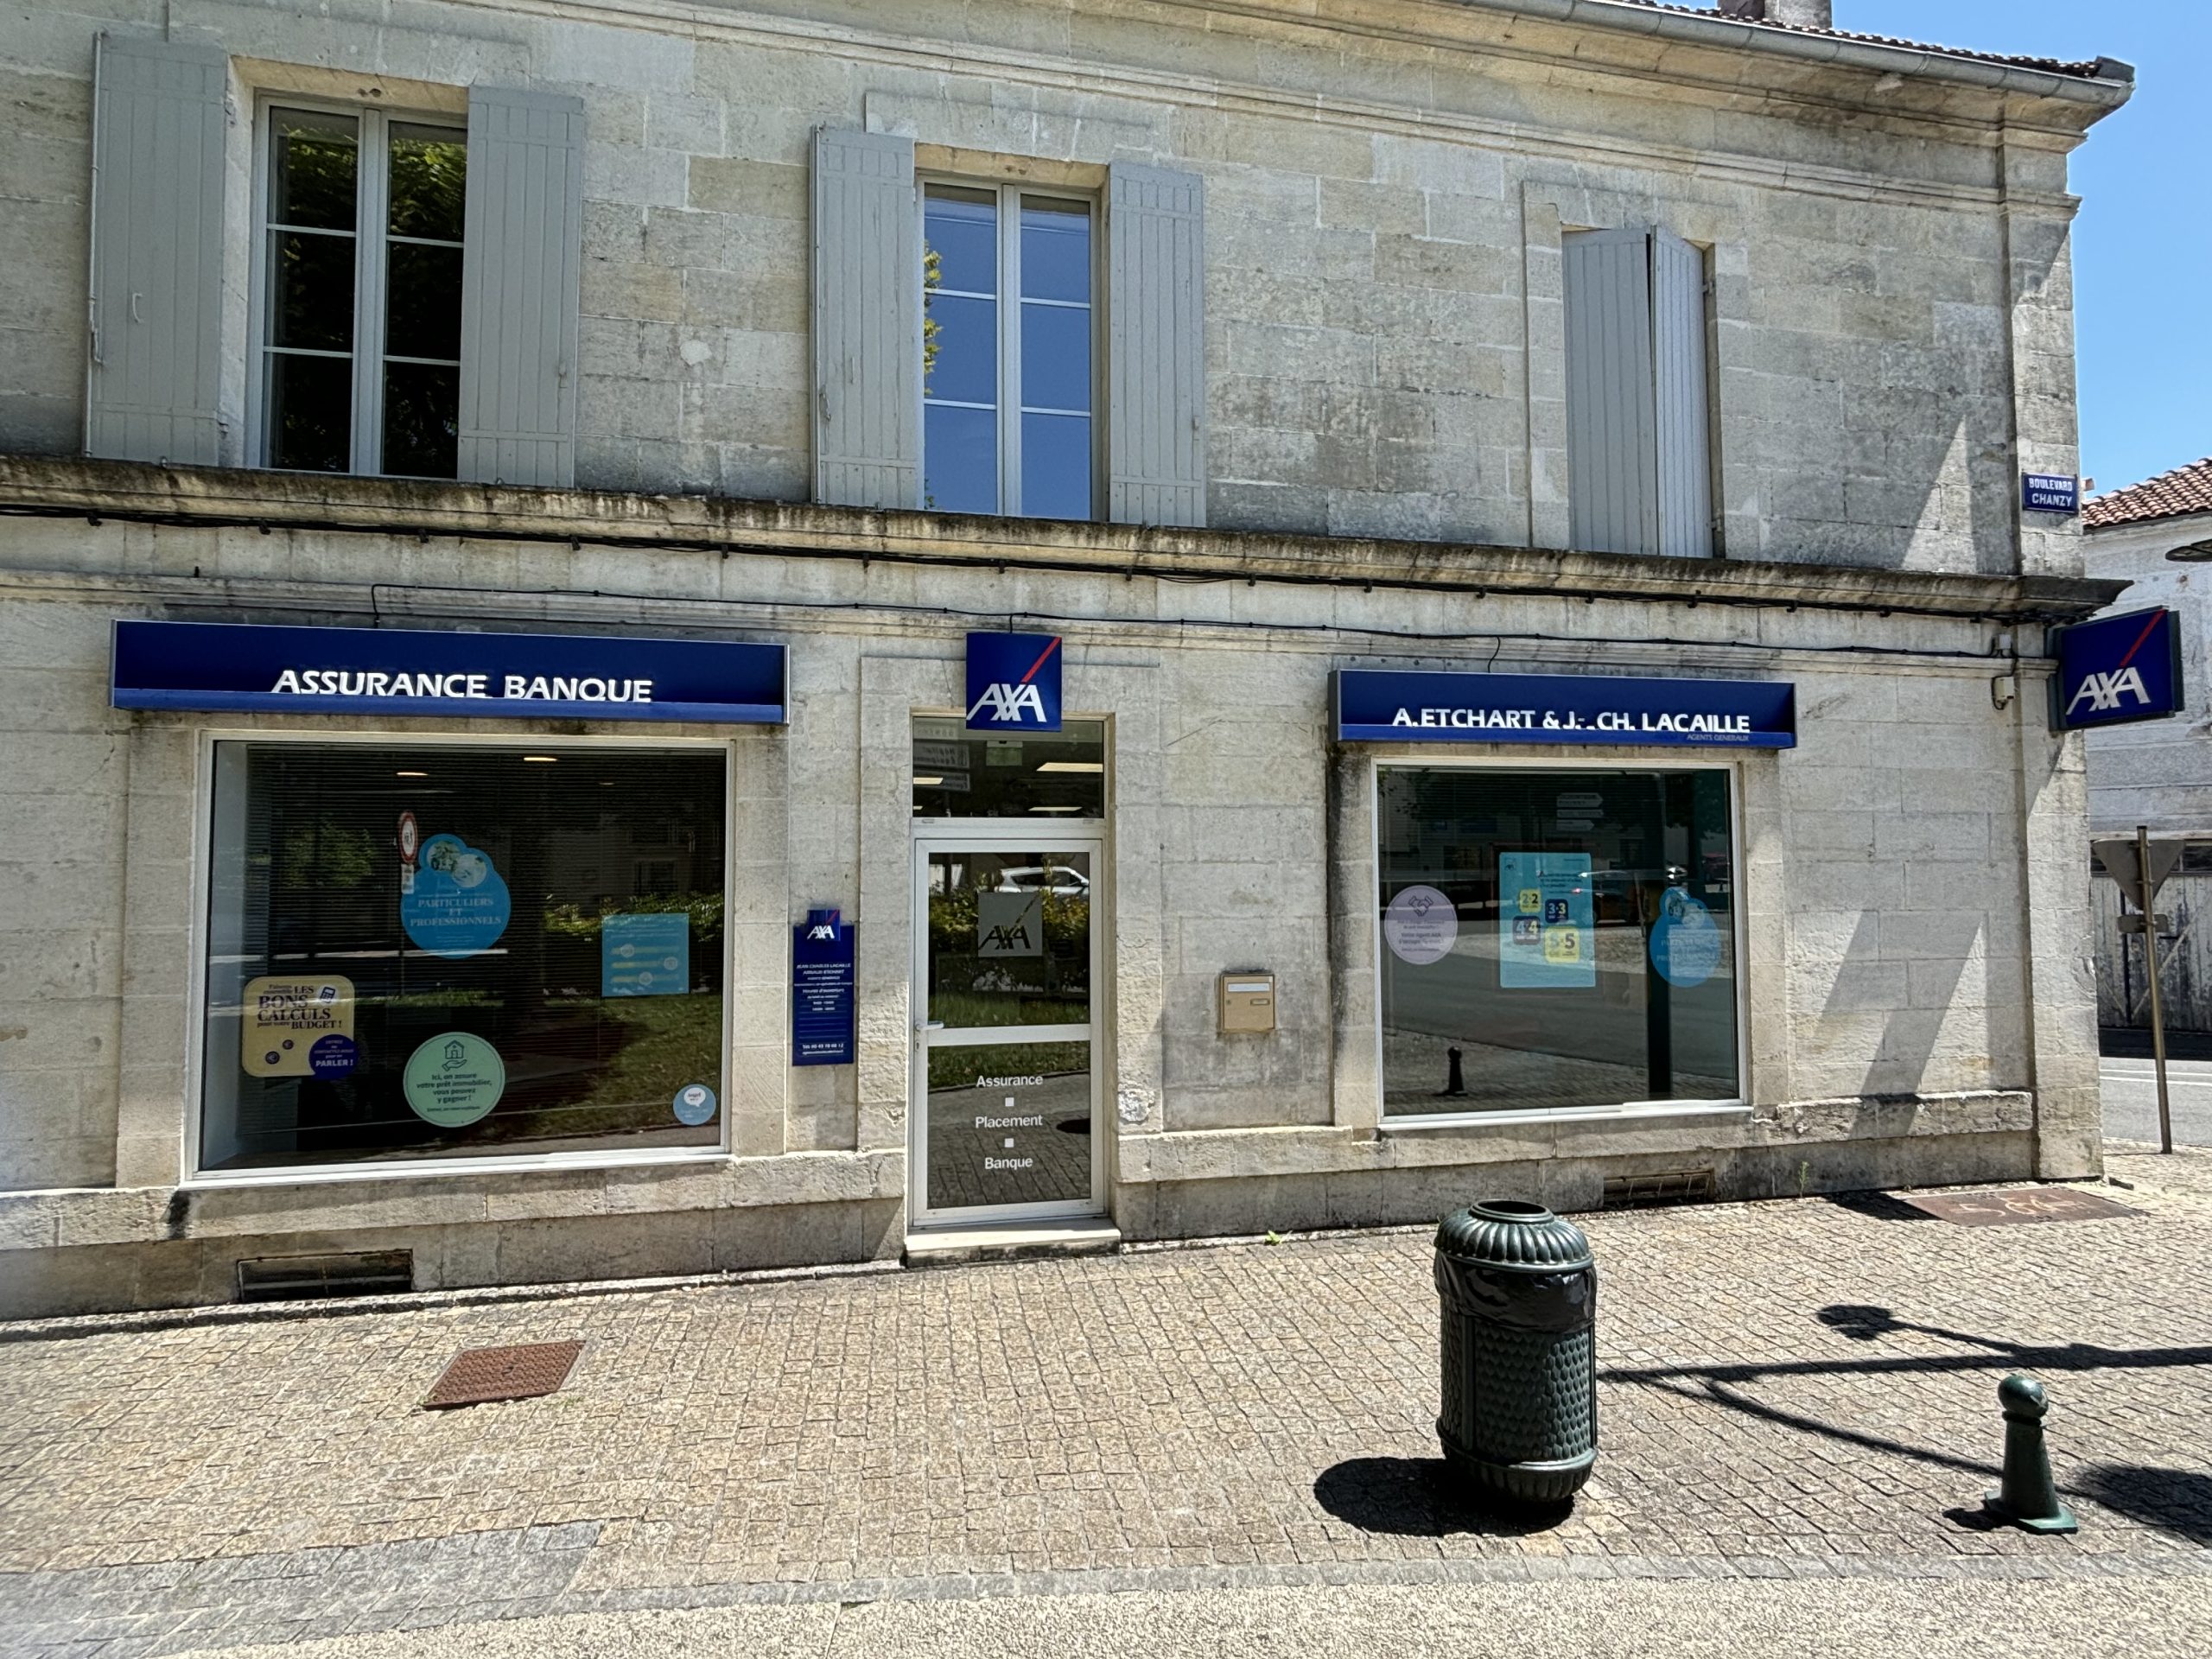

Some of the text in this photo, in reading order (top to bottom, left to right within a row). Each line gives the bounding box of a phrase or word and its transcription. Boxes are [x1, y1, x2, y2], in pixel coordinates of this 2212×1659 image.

[2028, 477, 2073, 492] BOULEVARD
[2031, 493, 2073, 507] CHANZY
[271, 670, 653, 702] ASSURANCE BANQUE
[2066, 666, 2152, 715] AXA
[966, 683, 1047, 722] AXA
[1392, 708, 1535, 728] A.ETCHART
[1542, 710, 1560, 729] &
[1642, 713, 1750, 733] LACAILLE
[418, 897, 494, 908] PARTICULIERS
[1532, 893, 1538, 904] 2
[448, 907, 462, 916] ET
[1548, 903, 1566, 914] 3 3
[410, 916, 502, 927] PROFESSIONNELS
[1516, 920, 1538, 934] 4 4
[807, 925, 835, 939] AXA
[979, 925, 1031, 950] AXA
[1565, 933, 1575, 949] 5
[294, 986, 314, 995] LES
[258, 995, 308, 1008] BONS
[257, 1007, 331, 1021] CALCULS
[291, 1020, 336, 1030] BUDGET
[315, 1058, 348, 1067] PARLER
[976, 1075, 1044, 1088] Assurance
[975, 1114, 1044, 1128] Placement
[985, 1157, 1033, 1171] Banque
